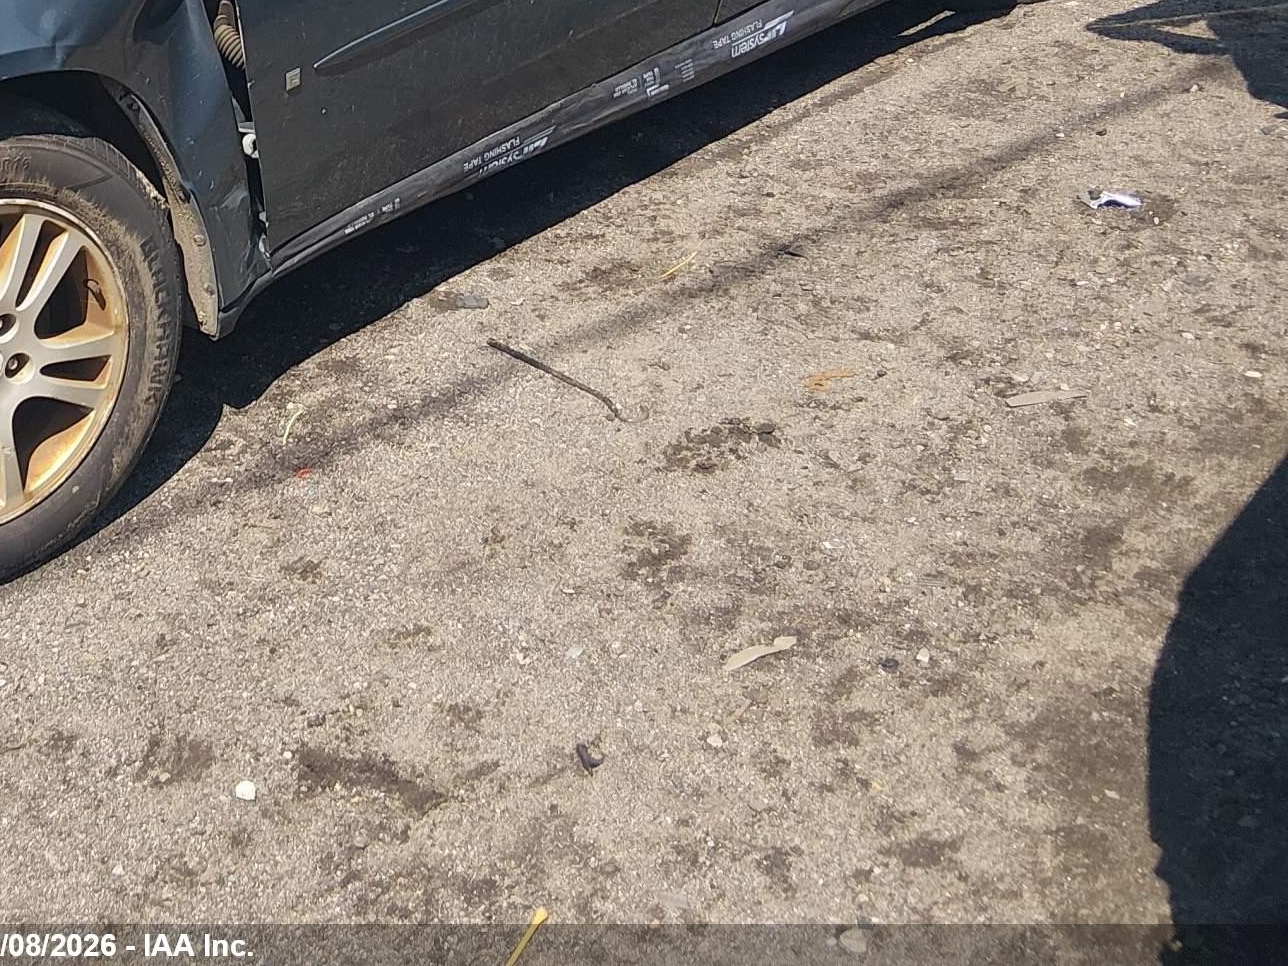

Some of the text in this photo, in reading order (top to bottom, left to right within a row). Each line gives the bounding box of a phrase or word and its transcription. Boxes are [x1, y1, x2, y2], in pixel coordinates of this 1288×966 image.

[712, 18, 763, 49] FLASHING TAPE
[483, 136, 520, 161] FLASHING
[463, 156, 482, 172] TAPE
